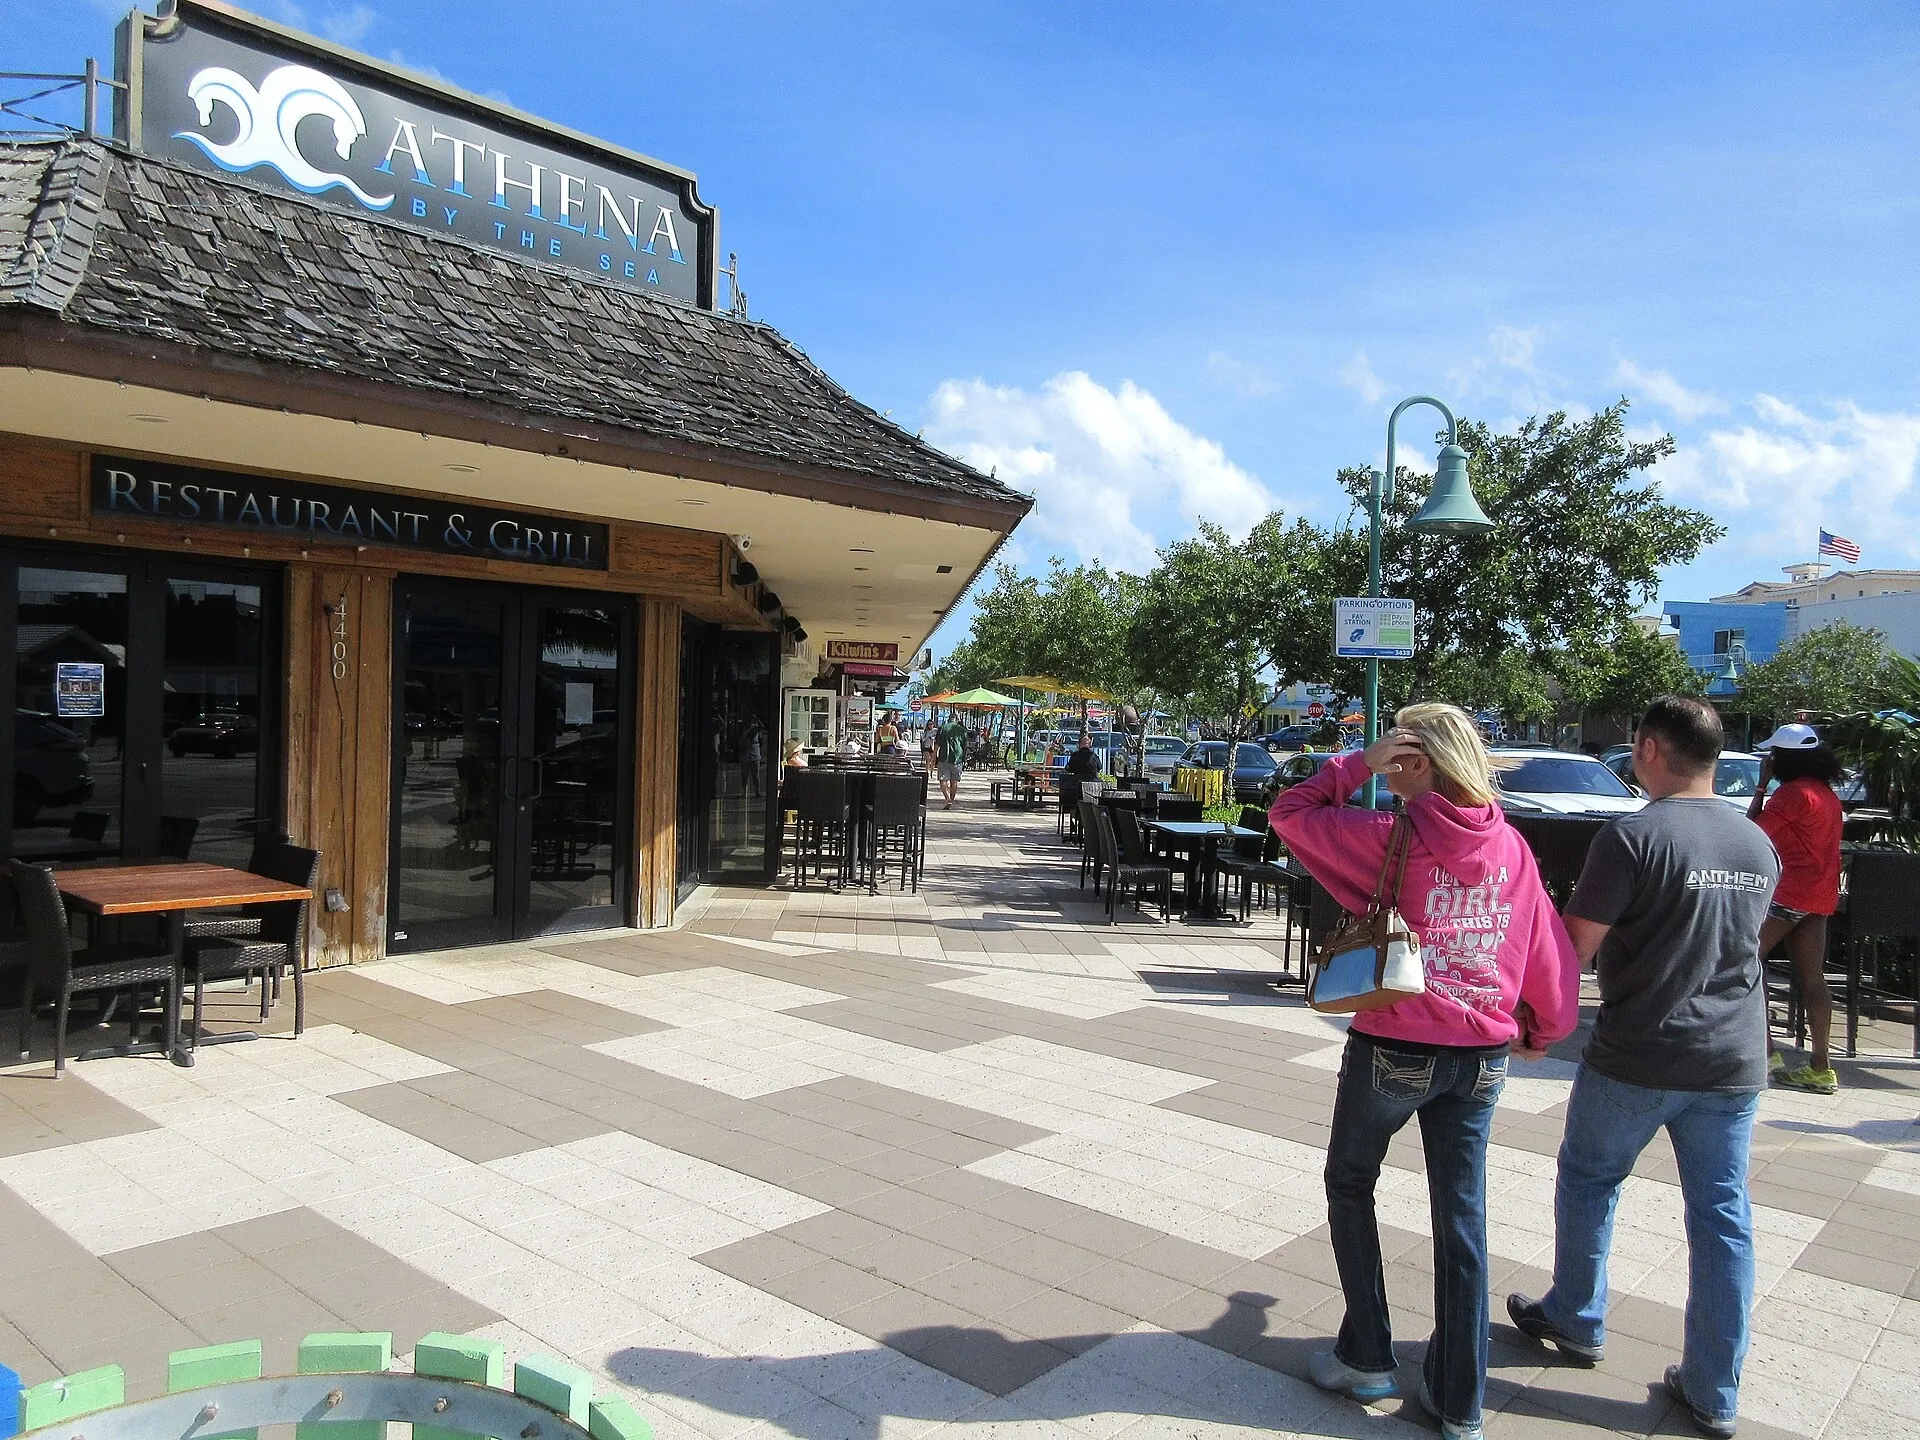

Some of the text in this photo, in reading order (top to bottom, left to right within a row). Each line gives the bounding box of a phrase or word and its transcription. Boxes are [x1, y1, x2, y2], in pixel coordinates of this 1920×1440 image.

[373, 116, 689, 266] ATHENA
[411, 198, 661, 287] BY THE SEA
[105, 468, 601, 564] RESTAURANT & GRILL
[1339, 600, 1412, 609] PARKING OPTIONS
[333, 602, 347, 680] 4400
[830, 641, 880, 659] Kilwin's
[1309, 706, 1323, 714] STOP
[1497, 866, 1510, 884] A
[1686, 869, 1769, 889] ANTHEM
[1706, 883, 1745, 891] OFF-ROAD
[1424, 884, 1513, 918] GIRL
[1450, 914, 1495, 930] THIS
[1496, 912, 1510, 929] IS
[1426, 930, 1451, 944] MY
